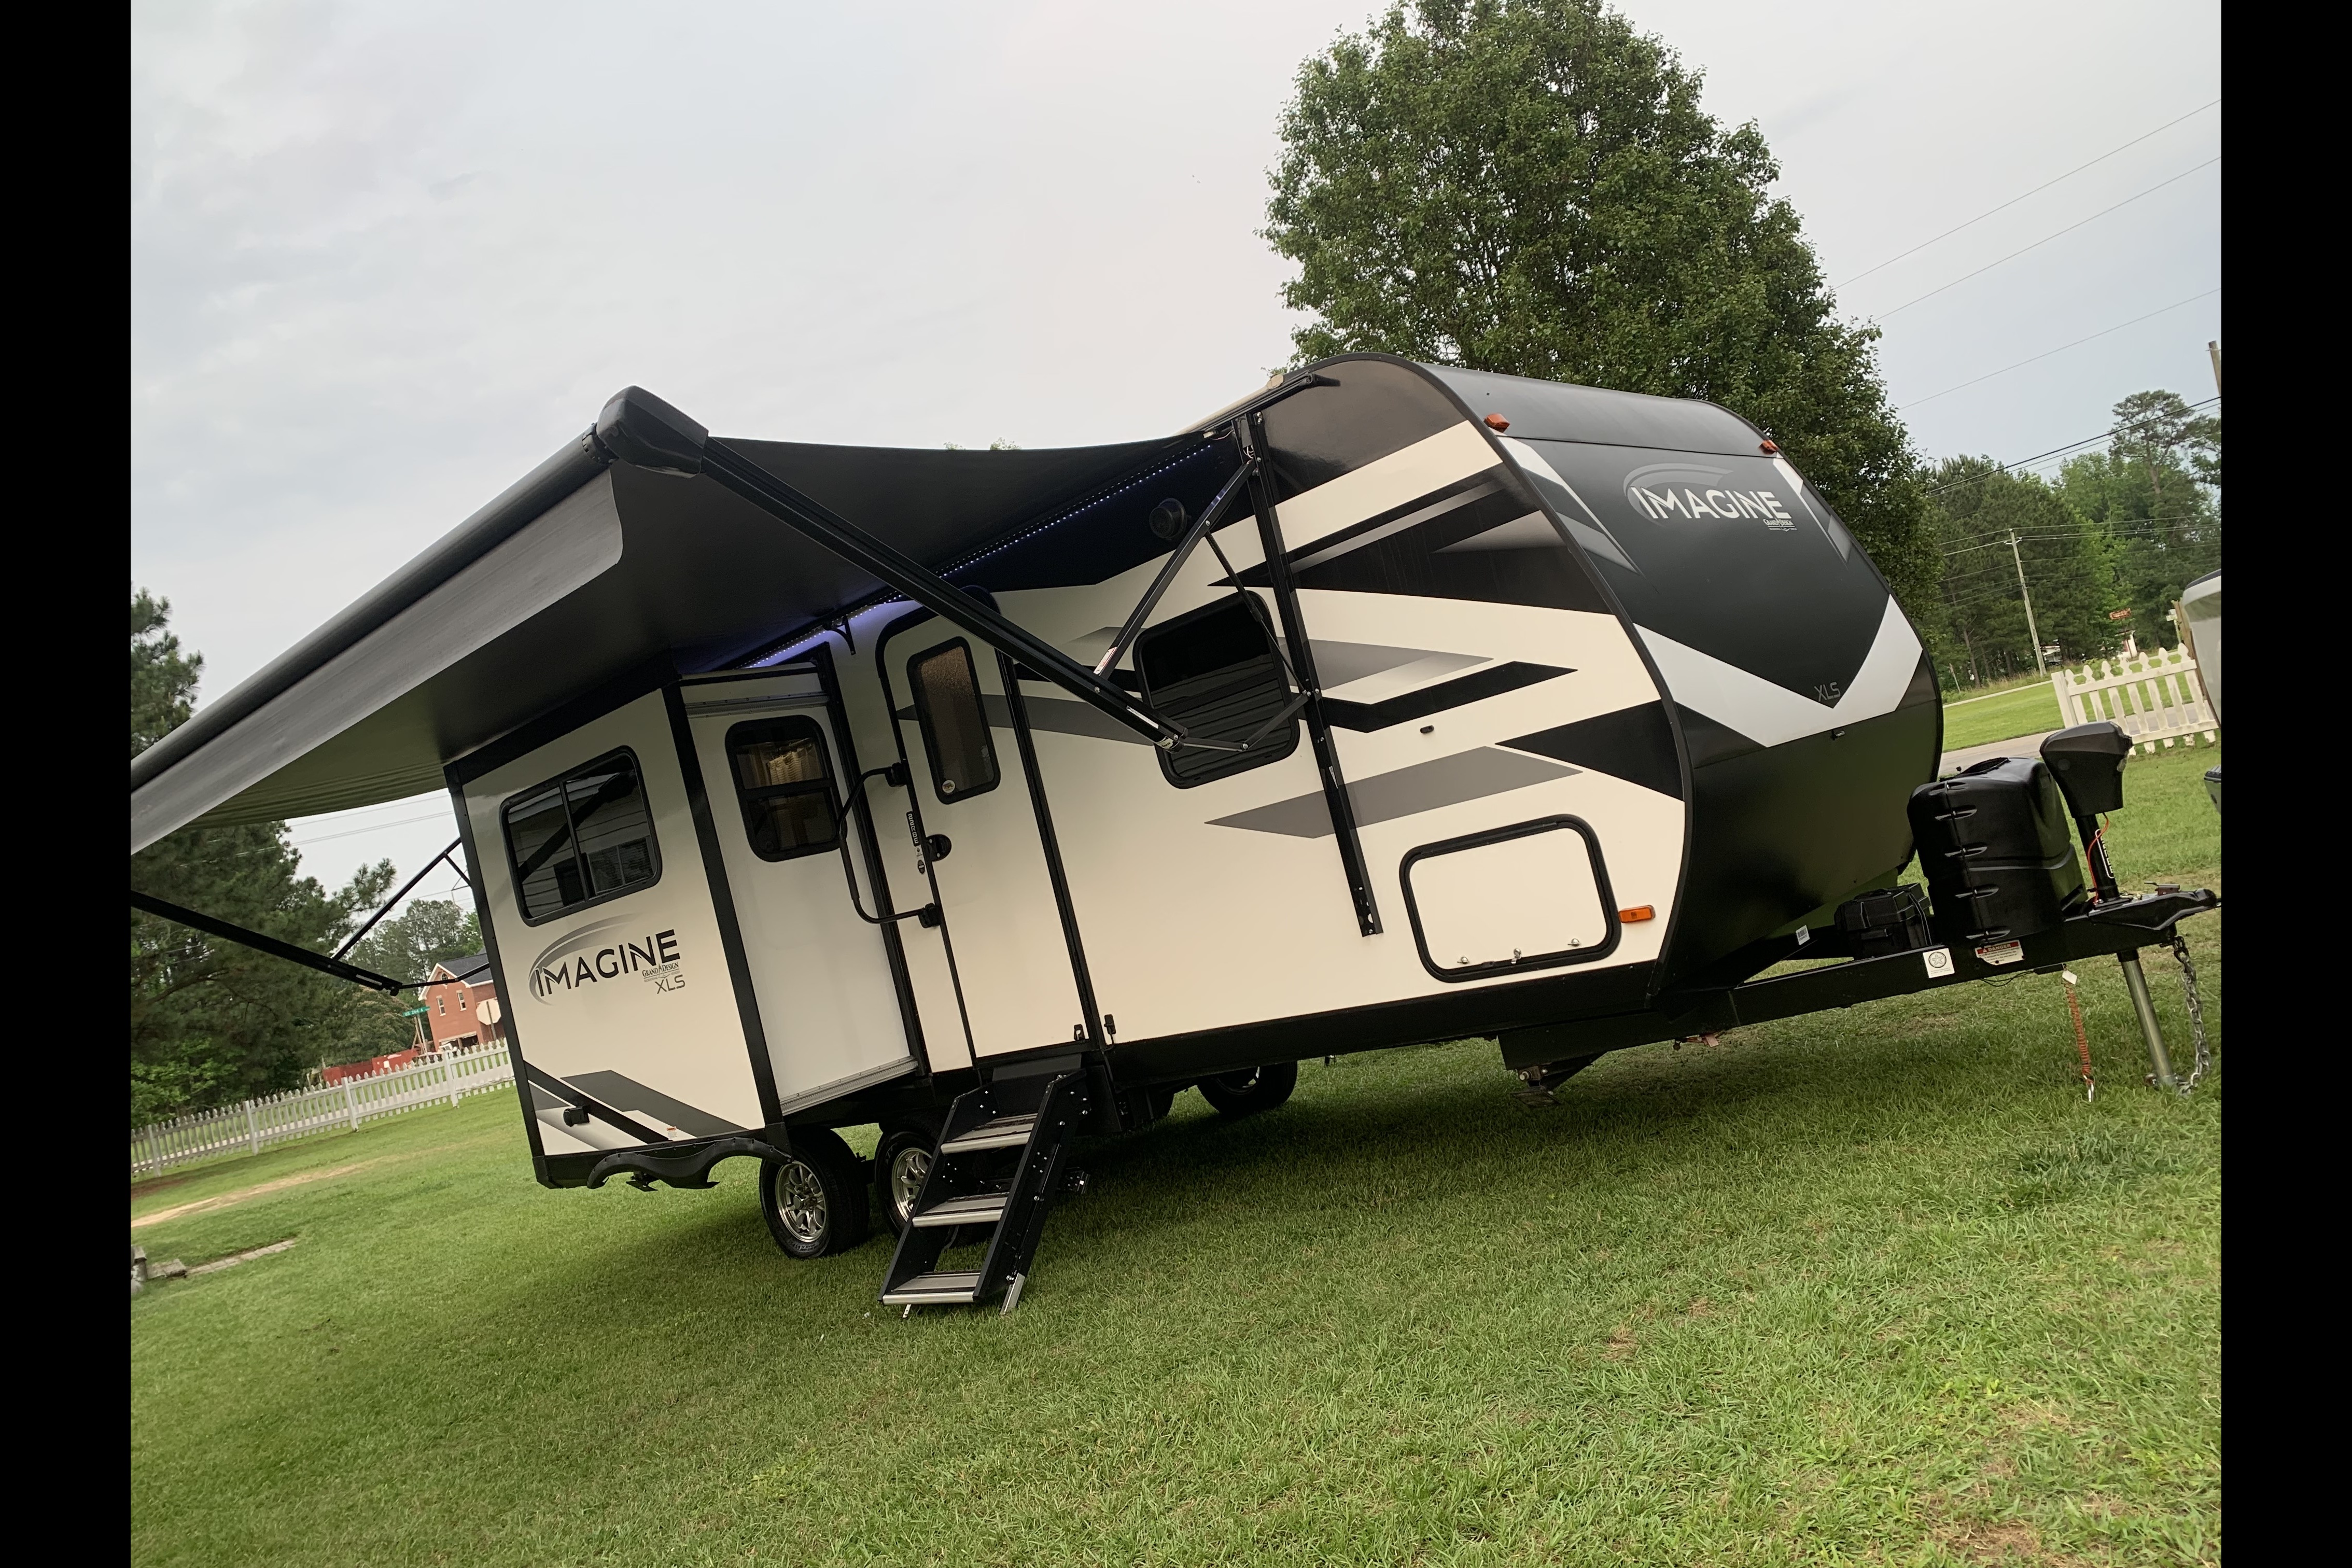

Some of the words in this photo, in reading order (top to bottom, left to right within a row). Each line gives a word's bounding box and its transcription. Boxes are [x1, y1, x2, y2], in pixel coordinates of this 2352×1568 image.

[1630, 486, 1792, 519] IMAGINE
[1814, 681, 1841, 702] XLS
[907, 813, 919, 844] 22RBE
[535, 929, 681, 997] IMAGINE
[642, 967, 659, 977] GRAND
[662, 961, 679, 972] DESIGN
[654, 974, 686, 995] XLS
